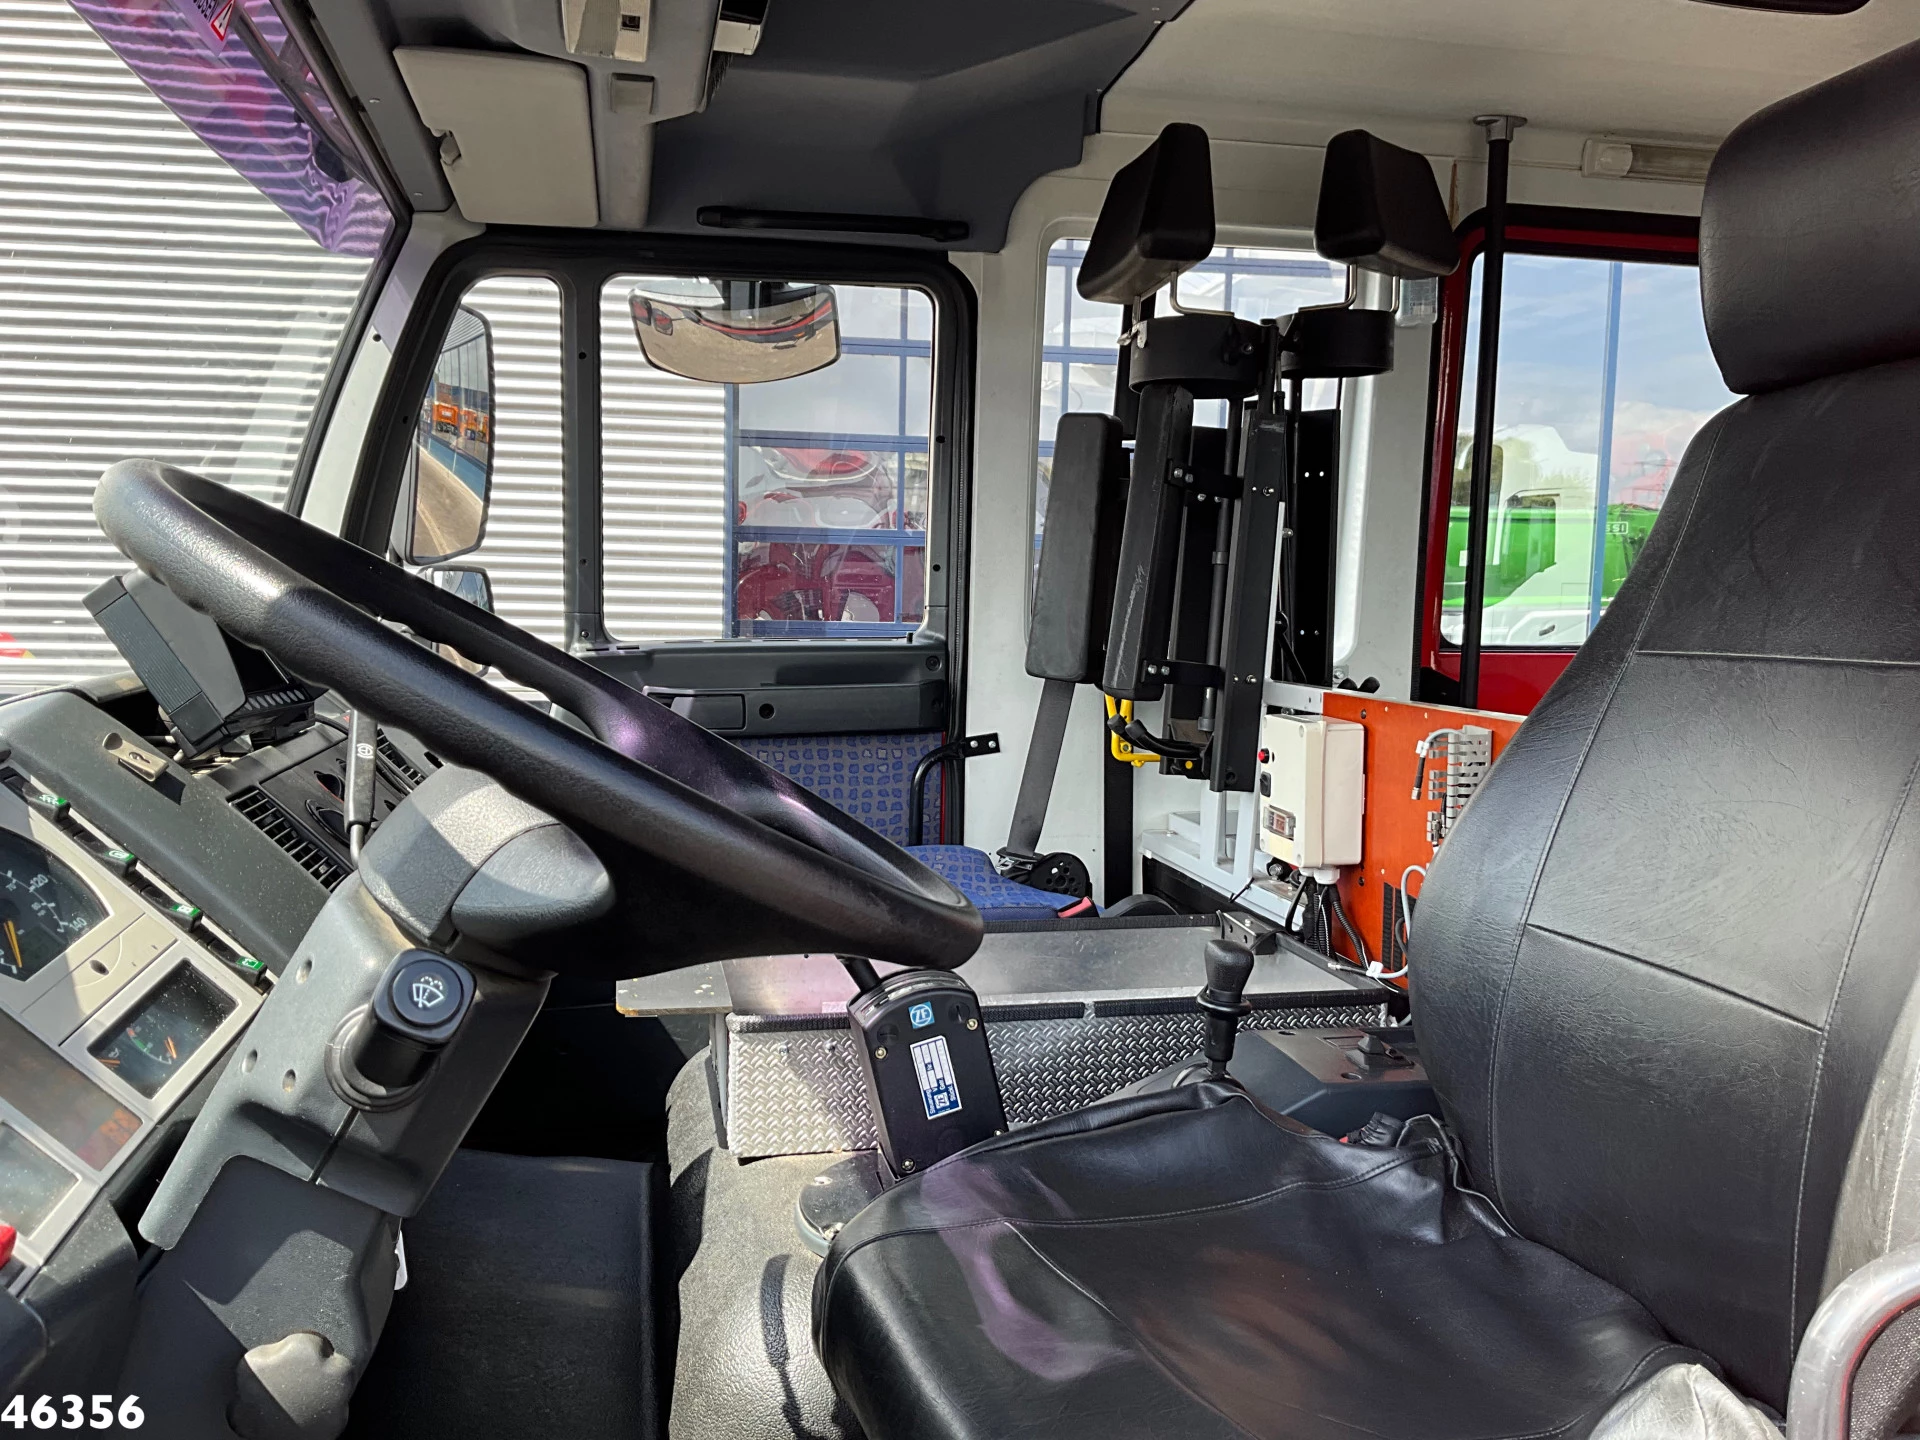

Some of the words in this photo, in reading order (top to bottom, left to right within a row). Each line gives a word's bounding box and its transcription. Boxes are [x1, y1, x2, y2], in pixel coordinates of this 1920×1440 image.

[30, 874, 49, 888] 120
[69, 917, 87, 931] 140
[911, 1007, 930, 1023] ZF
